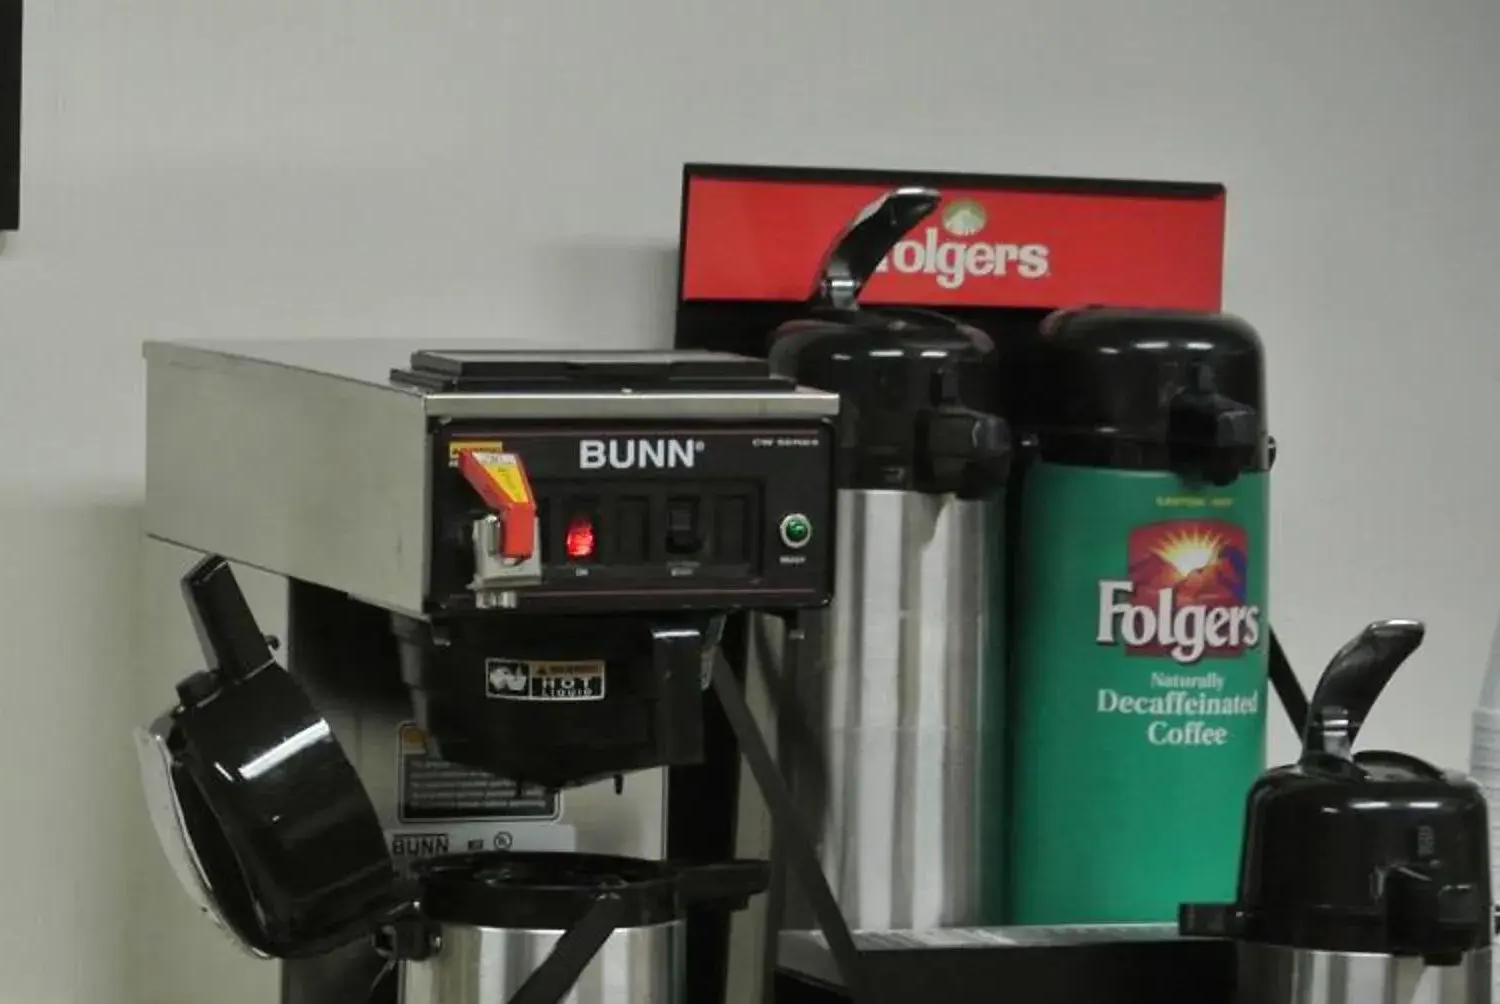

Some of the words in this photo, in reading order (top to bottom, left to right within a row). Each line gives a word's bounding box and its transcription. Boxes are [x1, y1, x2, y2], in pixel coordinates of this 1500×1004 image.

[872, 227, 1050, 289] olgers
[579, 439, 694, 469] BUNN
[1096, 580, 1260, 663] Folgers
[1151, 672, 1225, 691] Naturally
[1097, 688, 1258, 716] Decaffeinated
[1148, 721, 1228, 746] Coffee
